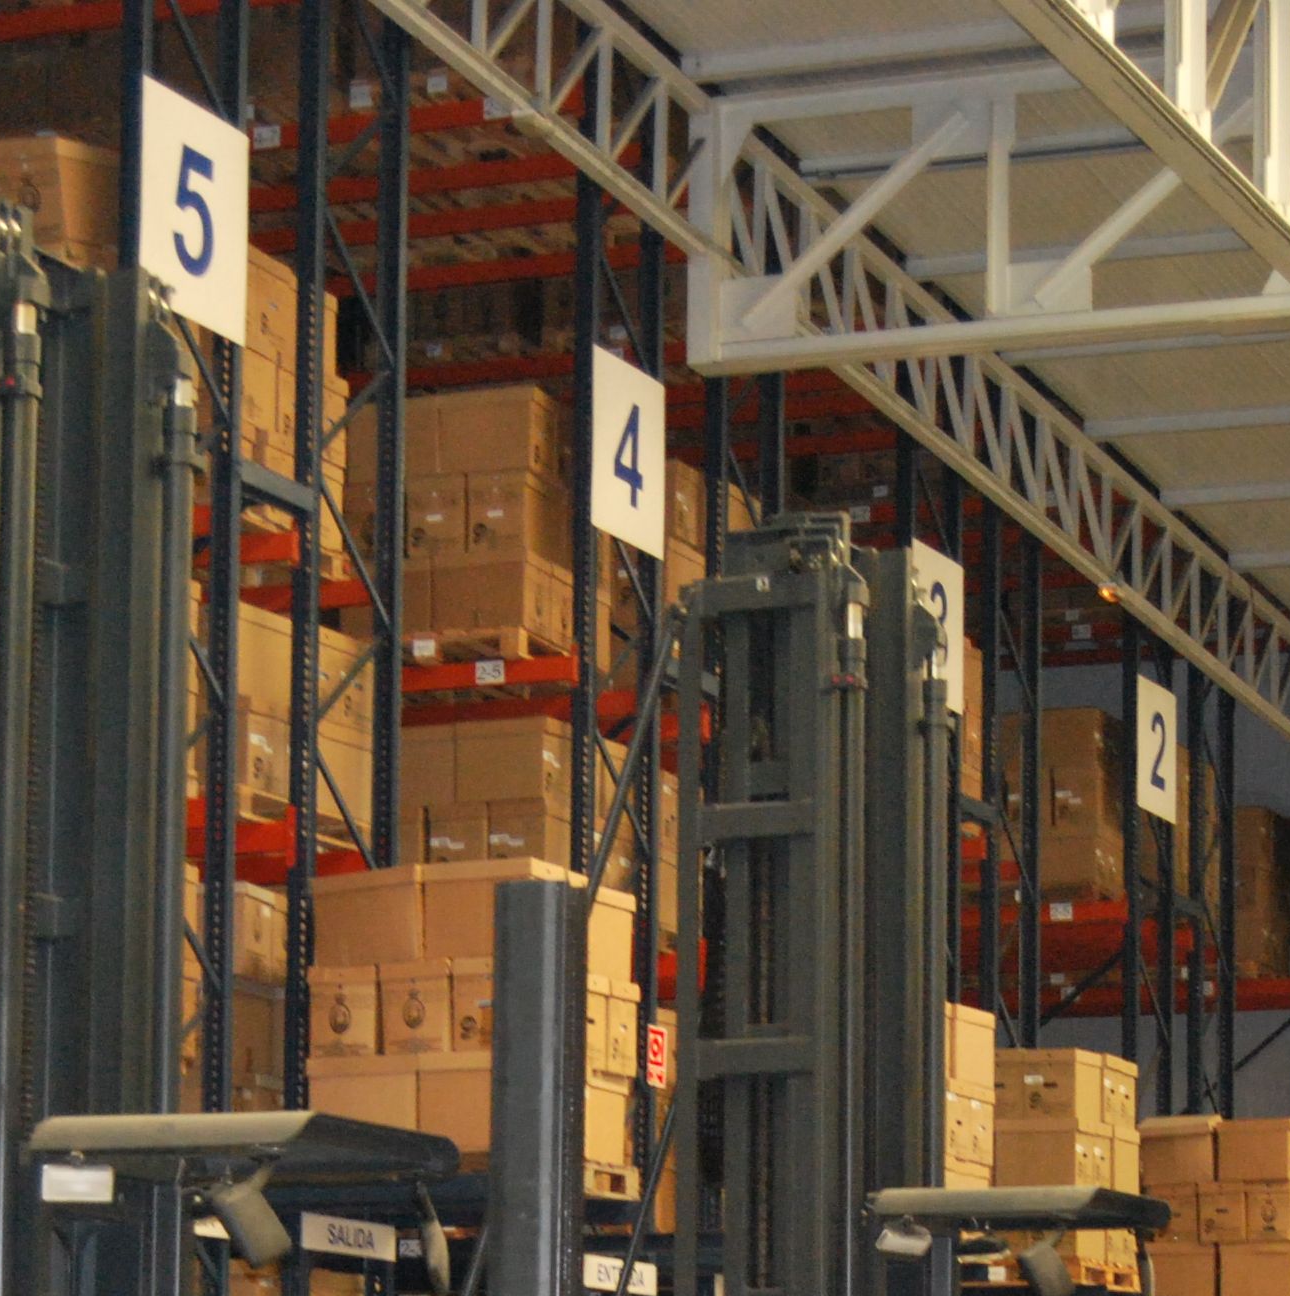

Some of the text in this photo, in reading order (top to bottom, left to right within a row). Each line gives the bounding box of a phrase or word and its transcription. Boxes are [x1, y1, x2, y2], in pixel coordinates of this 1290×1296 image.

[172, 144, 214, 278] 5
[614, 403, 644, 510] 4
[1150, 711, 1165, 792] 2
[328, 1223, 375, 1251] SALIDA
